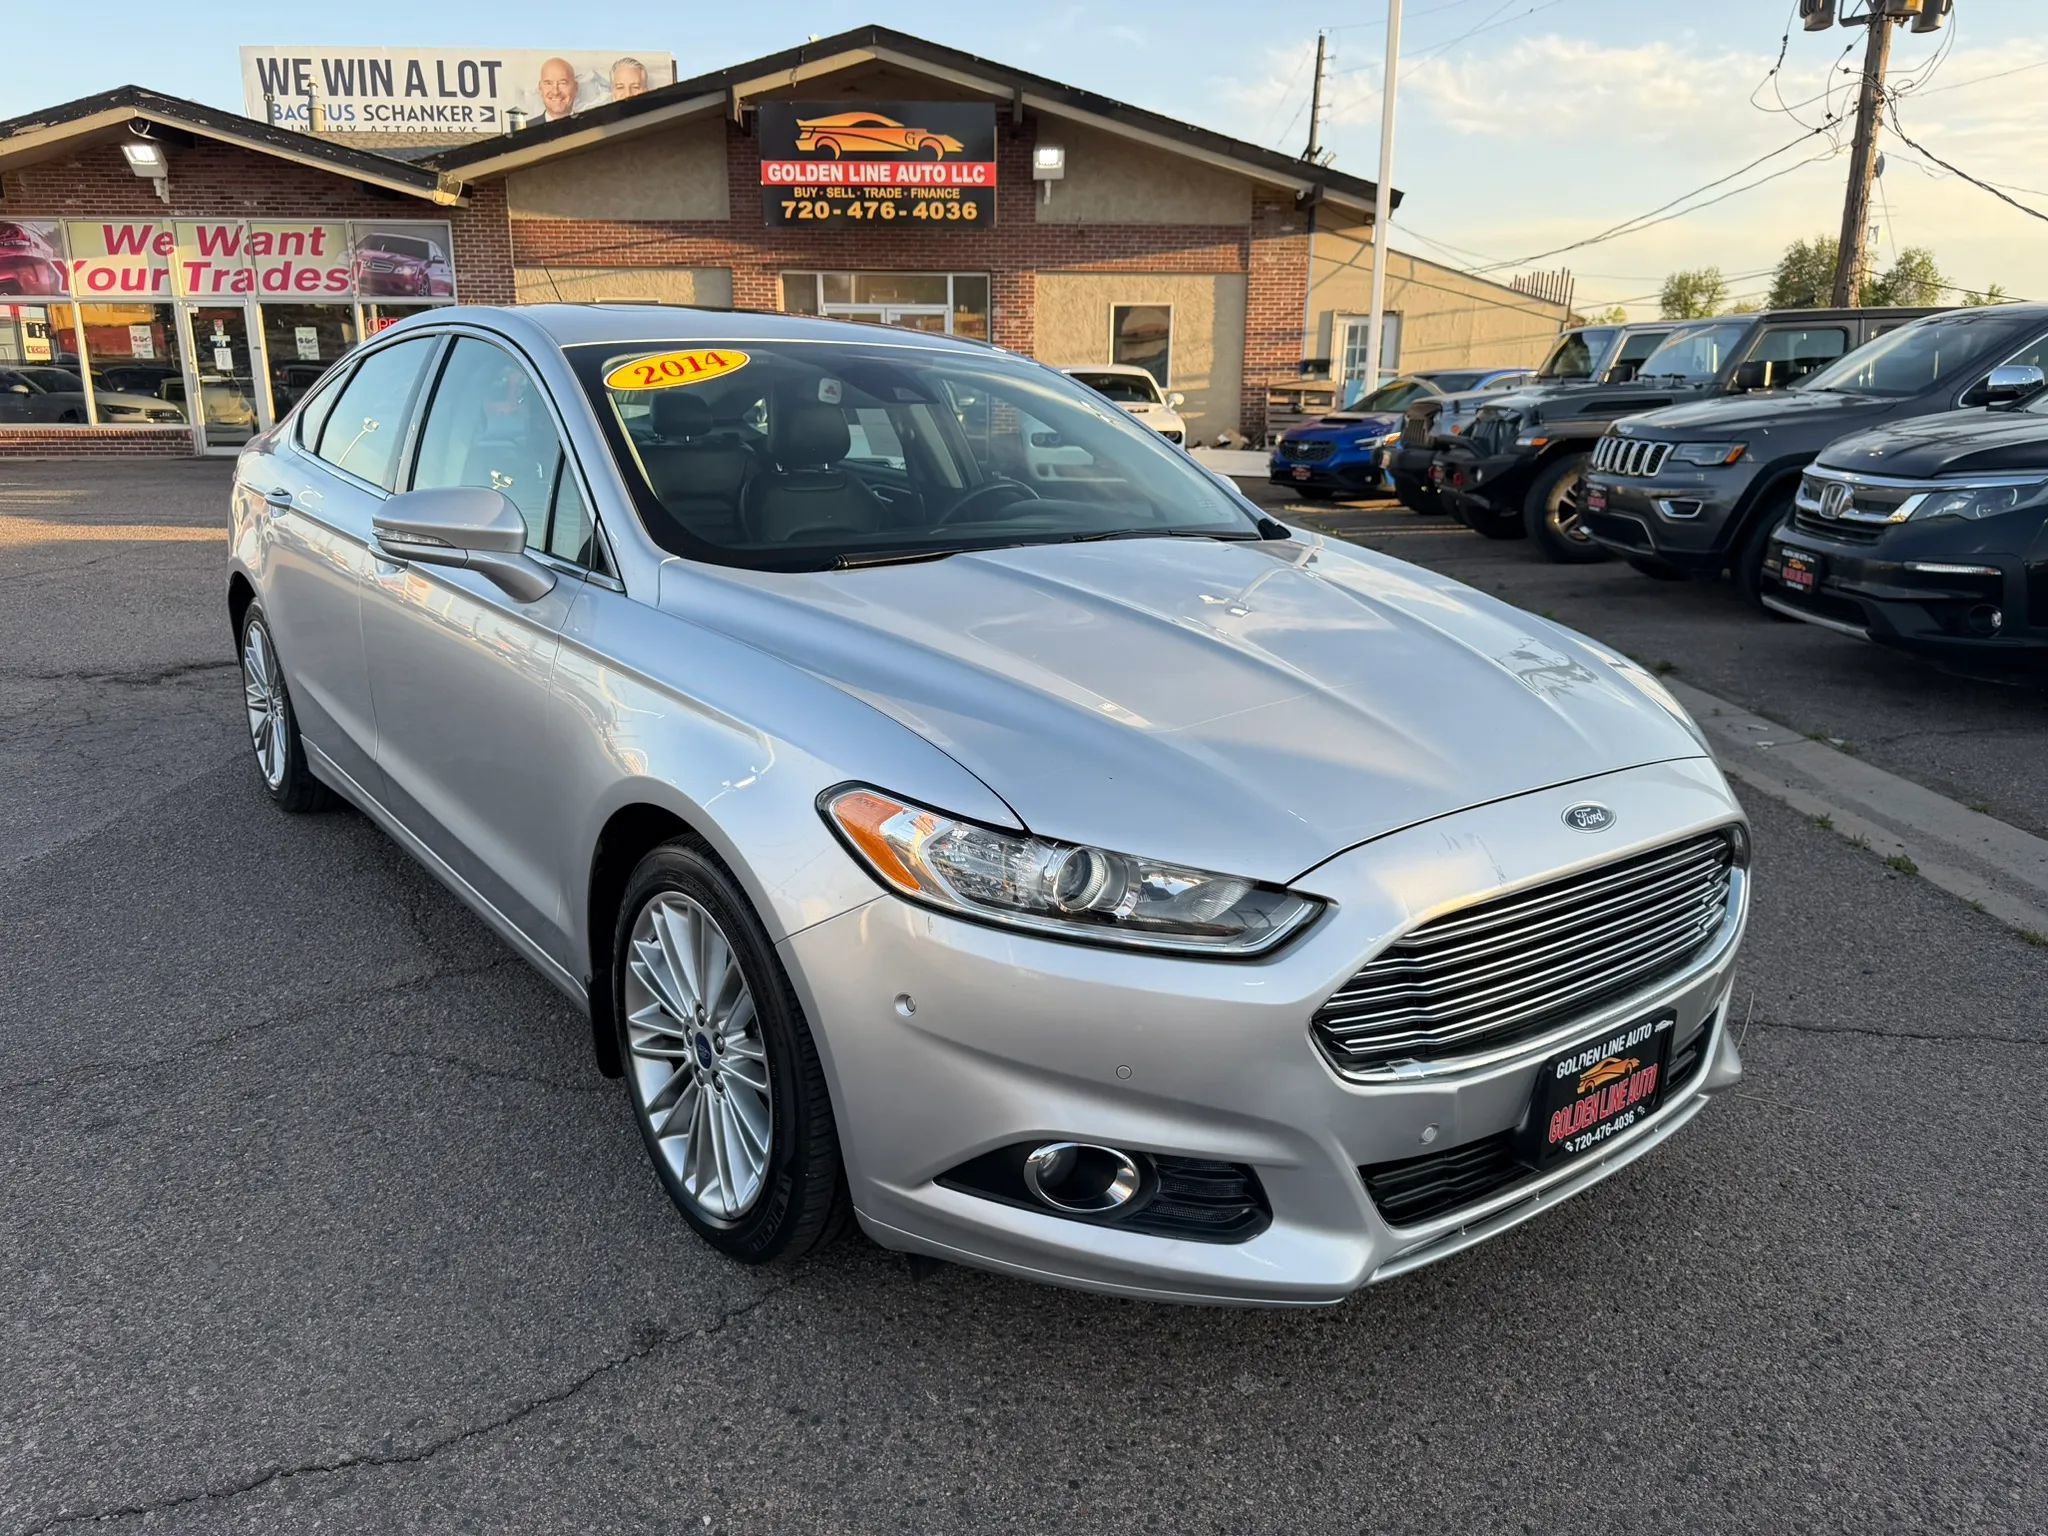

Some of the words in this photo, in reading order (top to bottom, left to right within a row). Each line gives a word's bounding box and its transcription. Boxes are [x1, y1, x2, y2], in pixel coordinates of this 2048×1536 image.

[256, 58, 312, 96] WE
[321, 59, 394, 97] WIN
[405, 60, 428, 97] A
[436, 60, 502, 98] LOT
[273, 103, 356, 121] BACUS
[363, 104, 473, 122] SCHANKER
[767, 163, 843, 183] GOLDEN
[849, 164, 891, 183] LINE
[896, 165, 946, 183] AUTO
[951, 165, 986, 184] LLC
[793, 187, 817, 198] BUY
[826, 187, 855, 198] SELL
[863, 188, 903, 198] TRADE
[910, 188, 960, 199] FINANCE
[102, 224, 176, 256] We
[196, 225, 326, 256] Want
[51, 260, 170, 291] Your
[634, 351, 729, 385] 2014
[1574, 808, 1605, 827] Ford
[1556, 1045, 1601, 1079] GOLDEN
[1601, 1034, 1627, 1060] LINE
[1625, 1022, 1652, 1049] AUTO
[1549, 1090, 1600, 1144] GOLDEN
[1599, 1077, 1629, 1120] LINE
[1627, 1063, 1659, 1105] AUTO
[1574, 1110, 1635, 1152] 720-476-4036
